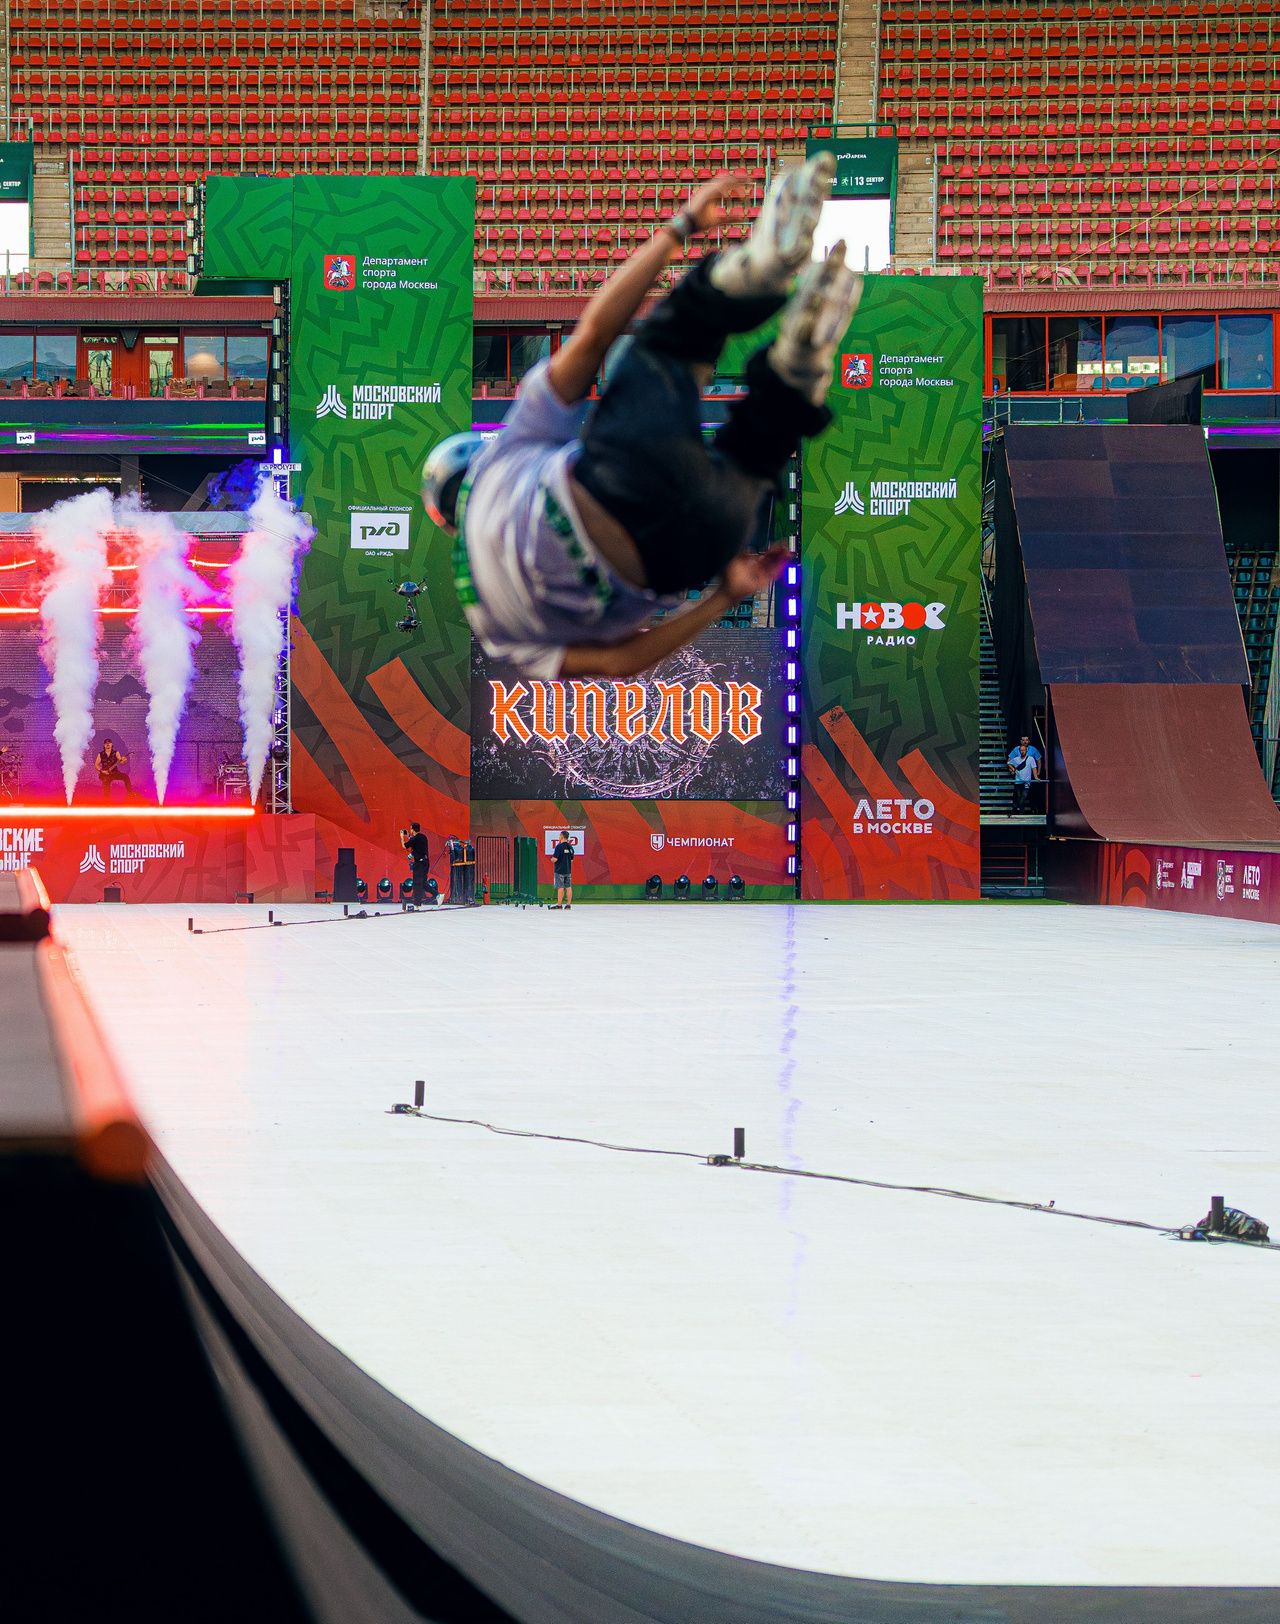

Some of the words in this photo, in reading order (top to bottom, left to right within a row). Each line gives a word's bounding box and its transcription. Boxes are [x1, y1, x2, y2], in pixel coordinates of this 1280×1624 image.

[855, 177, 864, 185] 13
[362, 256, 428, 267] Департамент
[362, 269, 396, 278] спорта
[362, 281, 396, 290] города
[399, 280, 438, 289] Москвы
[879, 354, 944, 364] Департамент
[879, 366, 913, 375] спорта
[879, 378, 913, 387] города
[915, 377, 953, 386] Москвы
[352, 383, 441, 403] МОСКОВСКИЙ
[352, 403, 394, 420] СПОРТ
[870, 478, 957, 499] МОСКОВСКИЙ
[870, 499, 911, 516] СПОРТ
[867, 635, 916, 646] РАДИО
[853, 798, 935, 820] ЛЕТО
[853, 823, 863, 834] В
[867, 823, 933, 834] МОСКВЕ
[667, 837, 734, 847] ЧЕМПИОНАТ
[110, 841, 185, 858] МОСКОВСКИЙ
[110, 859, 145, 873] СПОРТ
[1243, 865, 1261, 886] ЛЕТО
